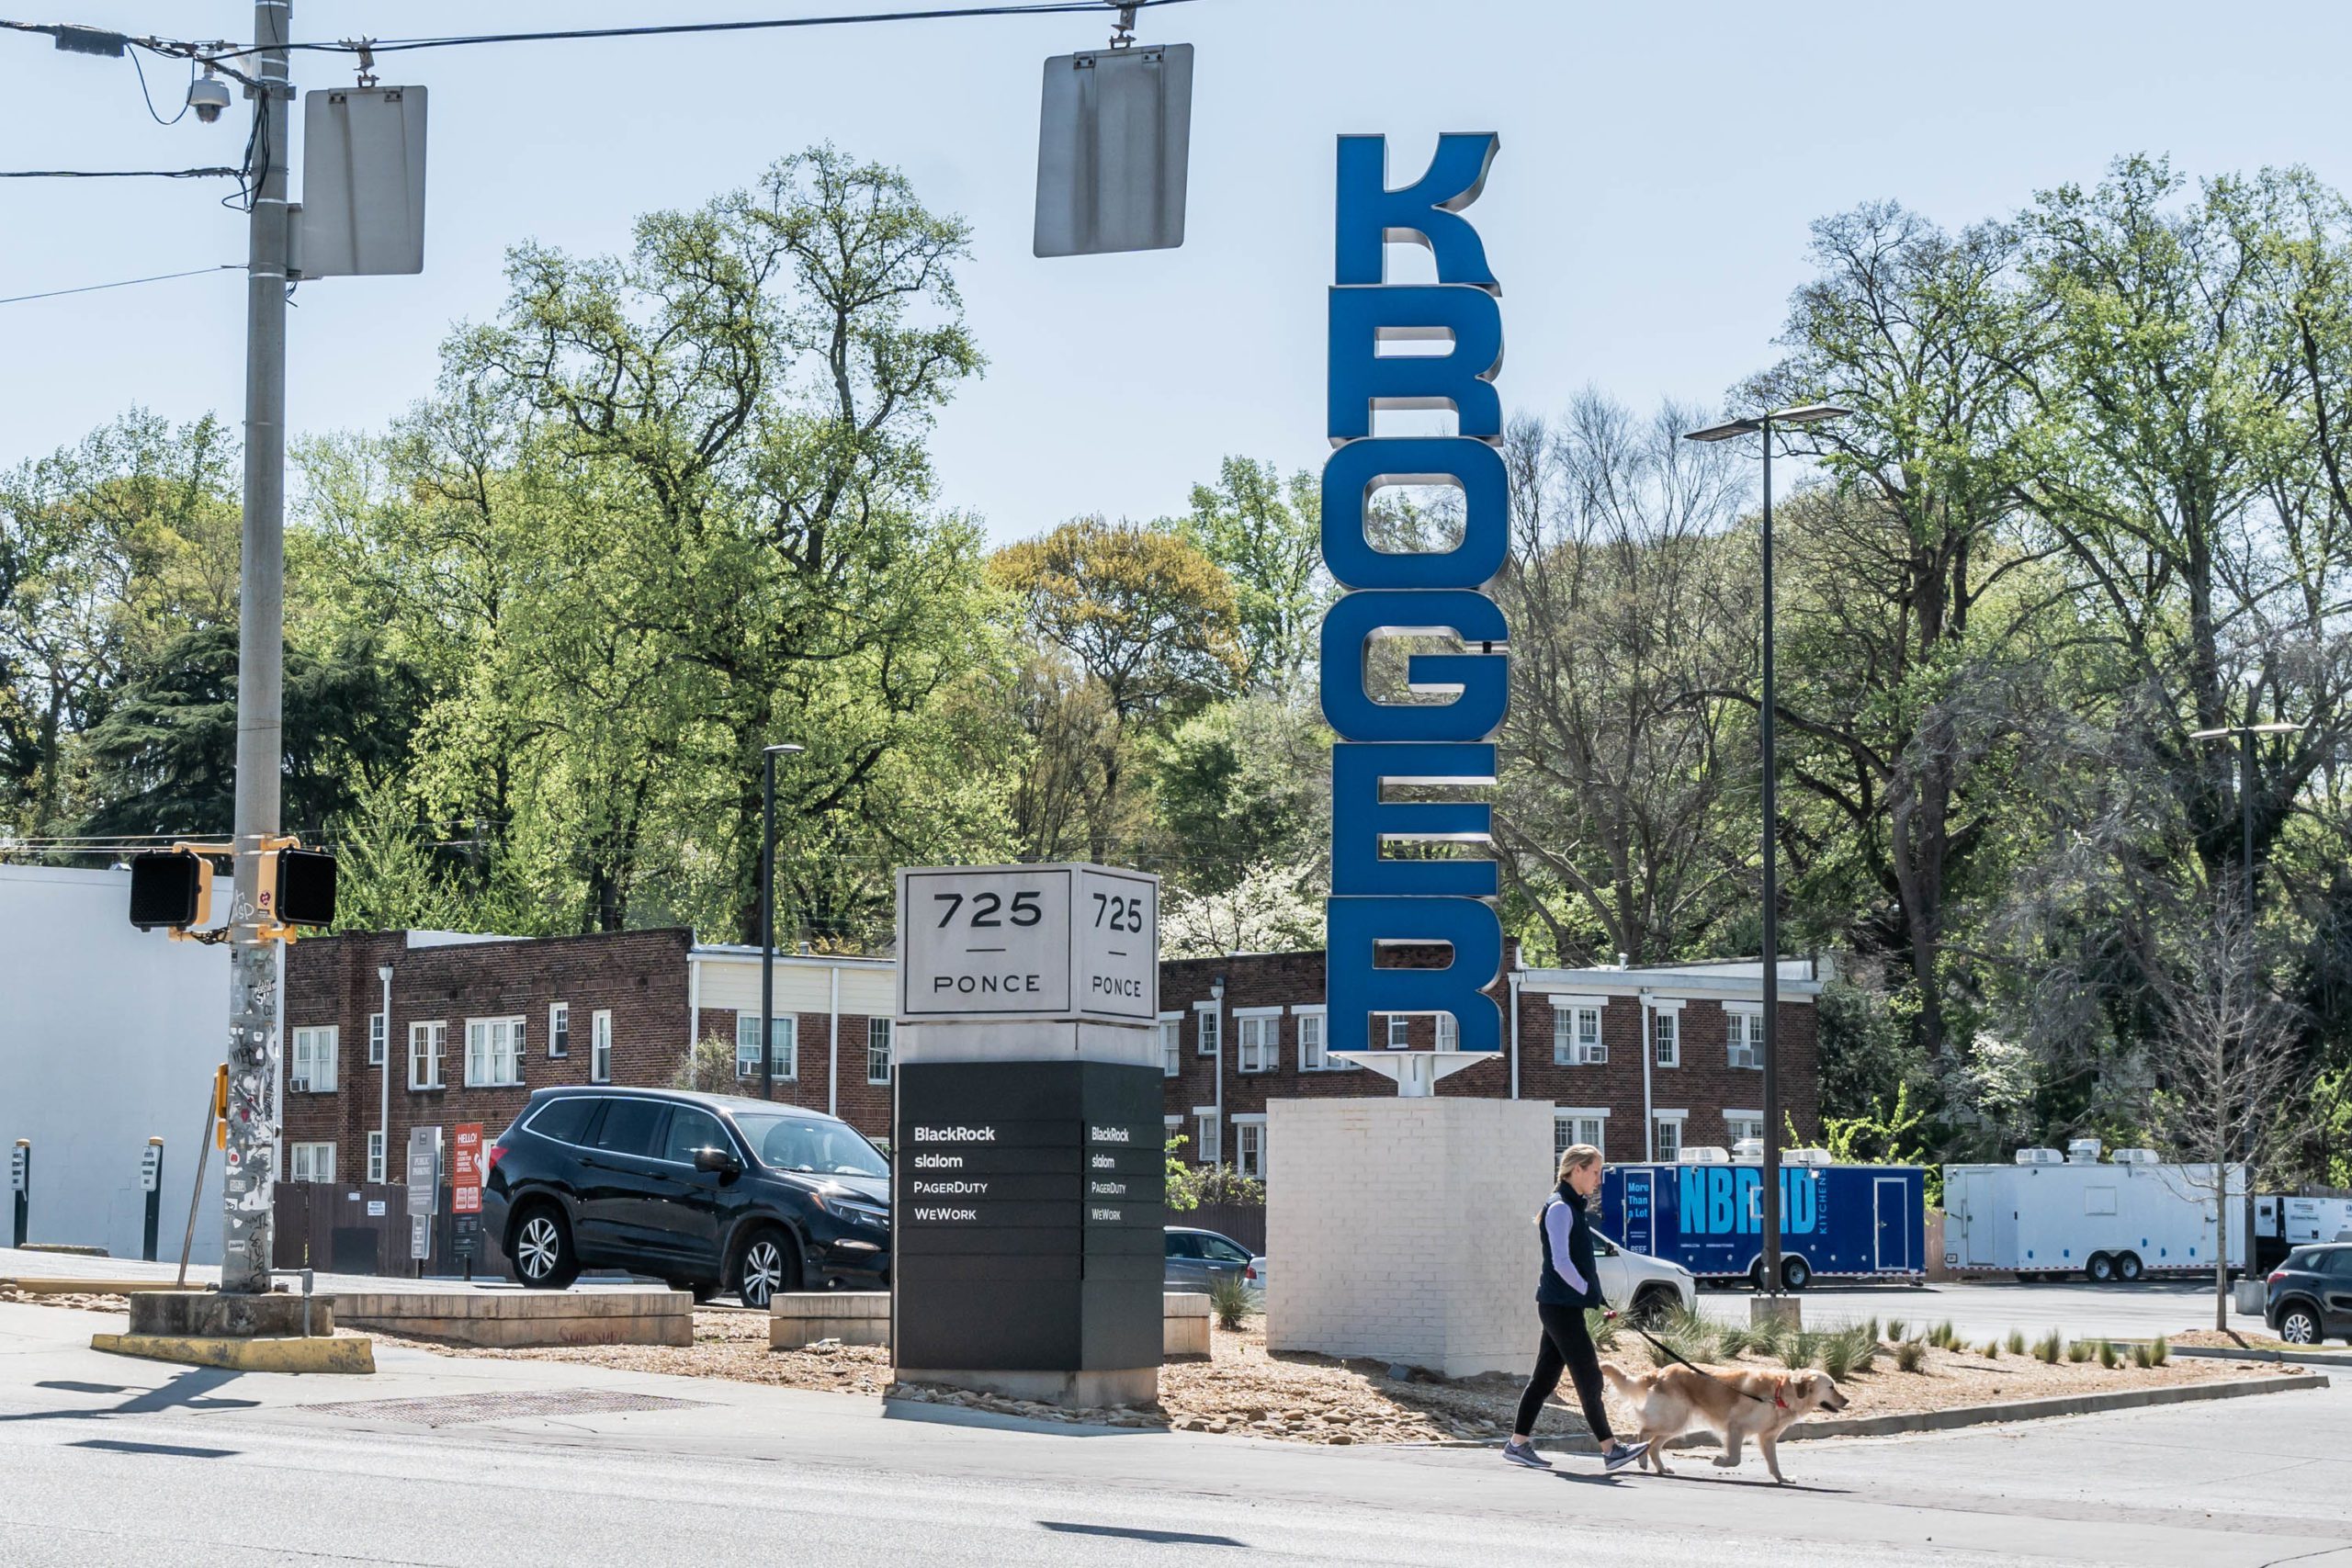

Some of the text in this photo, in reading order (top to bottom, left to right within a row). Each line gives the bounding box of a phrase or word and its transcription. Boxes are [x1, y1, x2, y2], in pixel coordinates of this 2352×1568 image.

[1320, 131, 1510, 1054] KROGER
[933, 891, 1042, 929] 725
[1092, 893, 1142, 933] 725
[933, 975, 1040, 993] PONCE
[1092, 976, 1141, 998] PONCE
[458, 1133, 477, 1144] HELLO!
[914, 1125, 995, 1142] BlackRock
[1091, 1126, 1129, 1143] BlackRock
[914, 1154, 963, 1168] slalom
[1091, 1155, 1114, 1168] slalom
[1627, 1182, 1649, 1192] More
[1628, 1195, 1648, 1205] Than
[1818, 1169, 1827, 1235] KITCHENS
[1635, 1208, 1648, 1218] Lot
